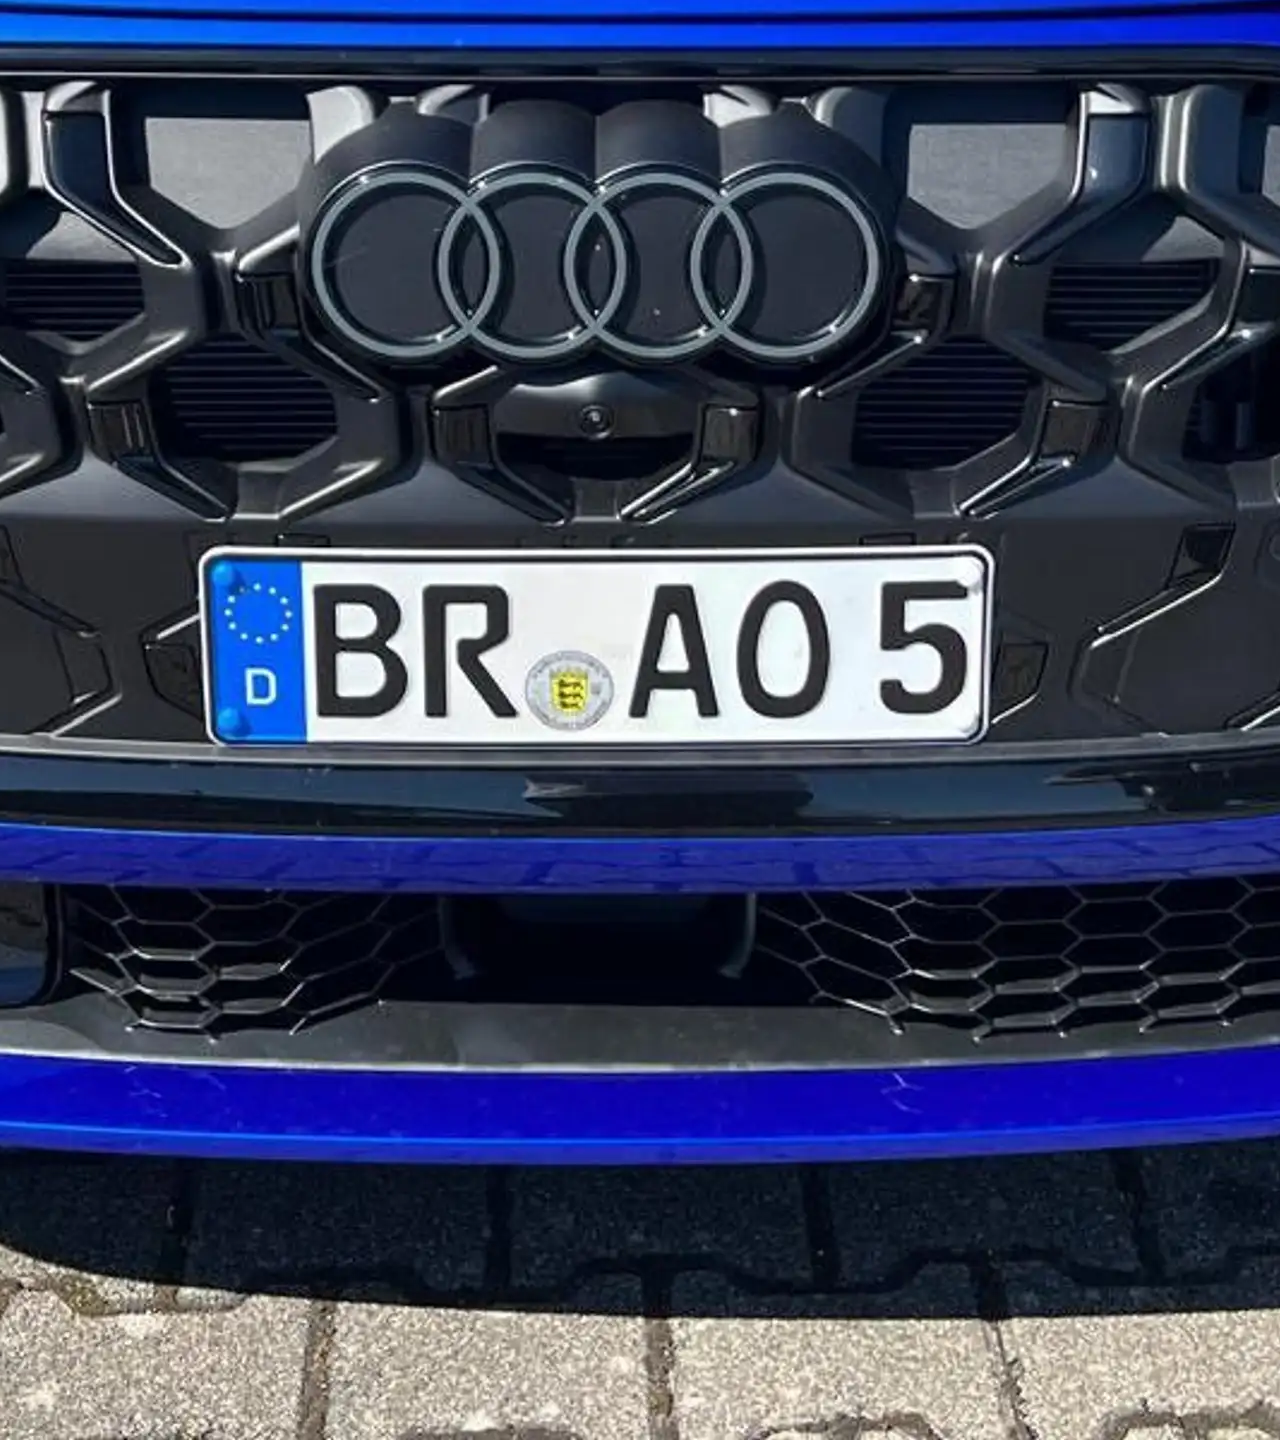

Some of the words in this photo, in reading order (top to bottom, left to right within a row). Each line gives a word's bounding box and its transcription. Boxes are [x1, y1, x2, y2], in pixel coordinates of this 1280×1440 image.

[245, 667, 277, 705] D
[313, 583, 519, 718] BR
[628, 579, 831, 719] AO
[879, 580, 968, 716] 5
